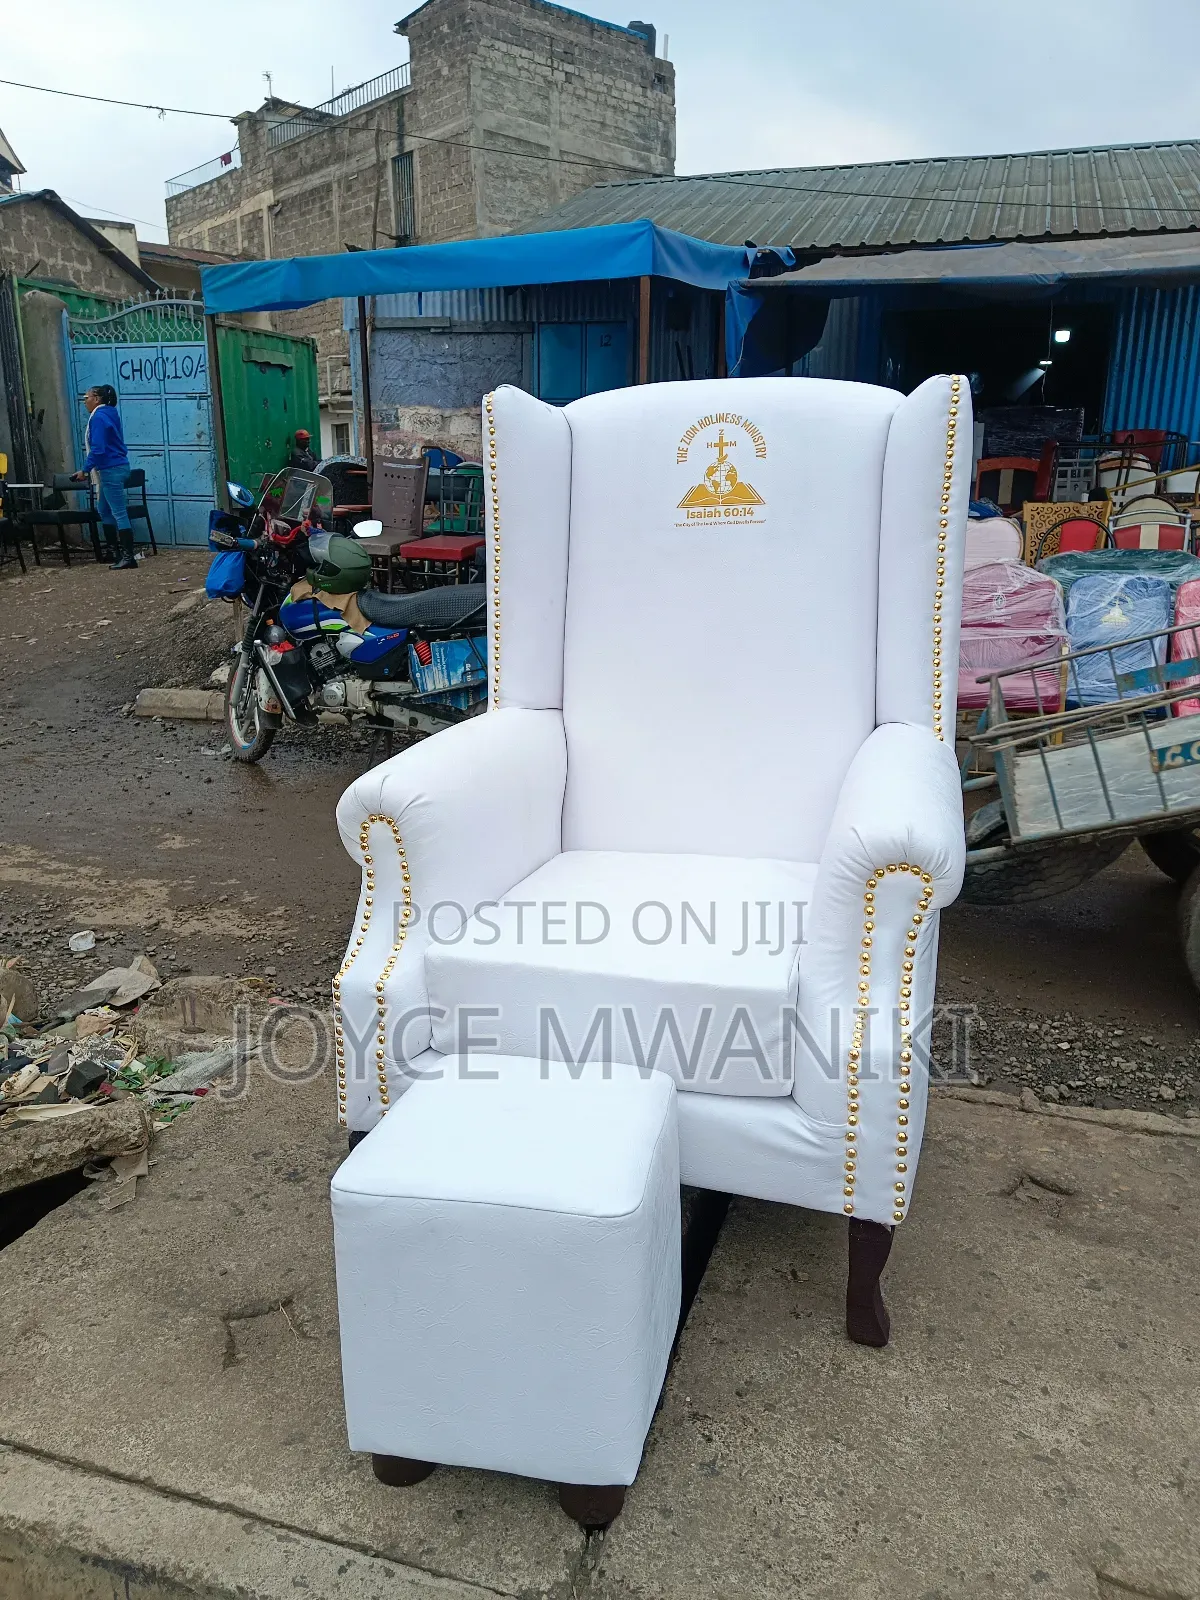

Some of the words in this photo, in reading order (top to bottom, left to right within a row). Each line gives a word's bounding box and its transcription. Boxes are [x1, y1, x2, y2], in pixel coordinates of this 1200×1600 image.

[600, 334, 612, 348] 12
[697, 412, 742, 429] HOLINESS
[680, 424, 700, 447] ZION
[741, 419, 767, 459] MINISTRY
[677, 446, 689, 465] THE
[686, 508, 721, 519] Isaiah
[723, 507, 755, 518] 60:14
